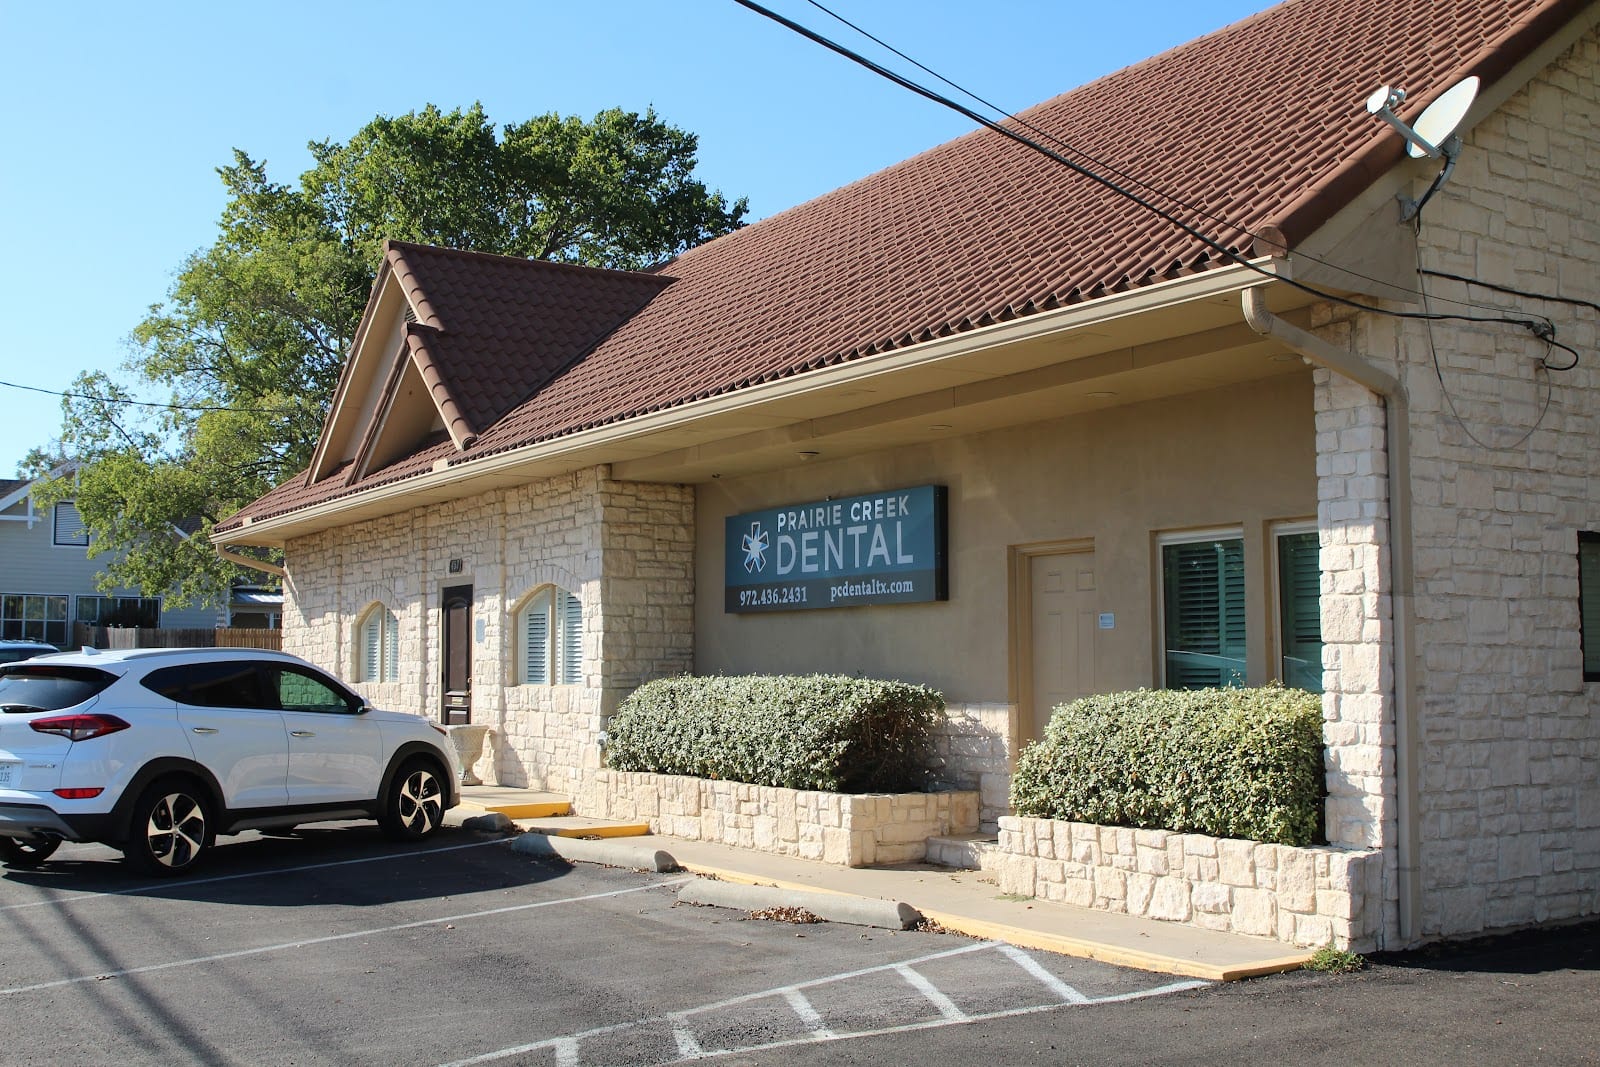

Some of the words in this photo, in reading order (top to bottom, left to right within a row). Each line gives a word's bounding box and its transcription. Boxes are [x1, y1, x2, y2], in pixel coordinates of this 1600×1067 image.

[777, 504, 842, 532] PRAIRIE
[850, 495, 910, 522] CREEK
[776, 521, 914, 575] DENTAL
[740, 586, 807, 606] 972.436.2431
[830, 579, 914, 601] pcdentaltx.com
